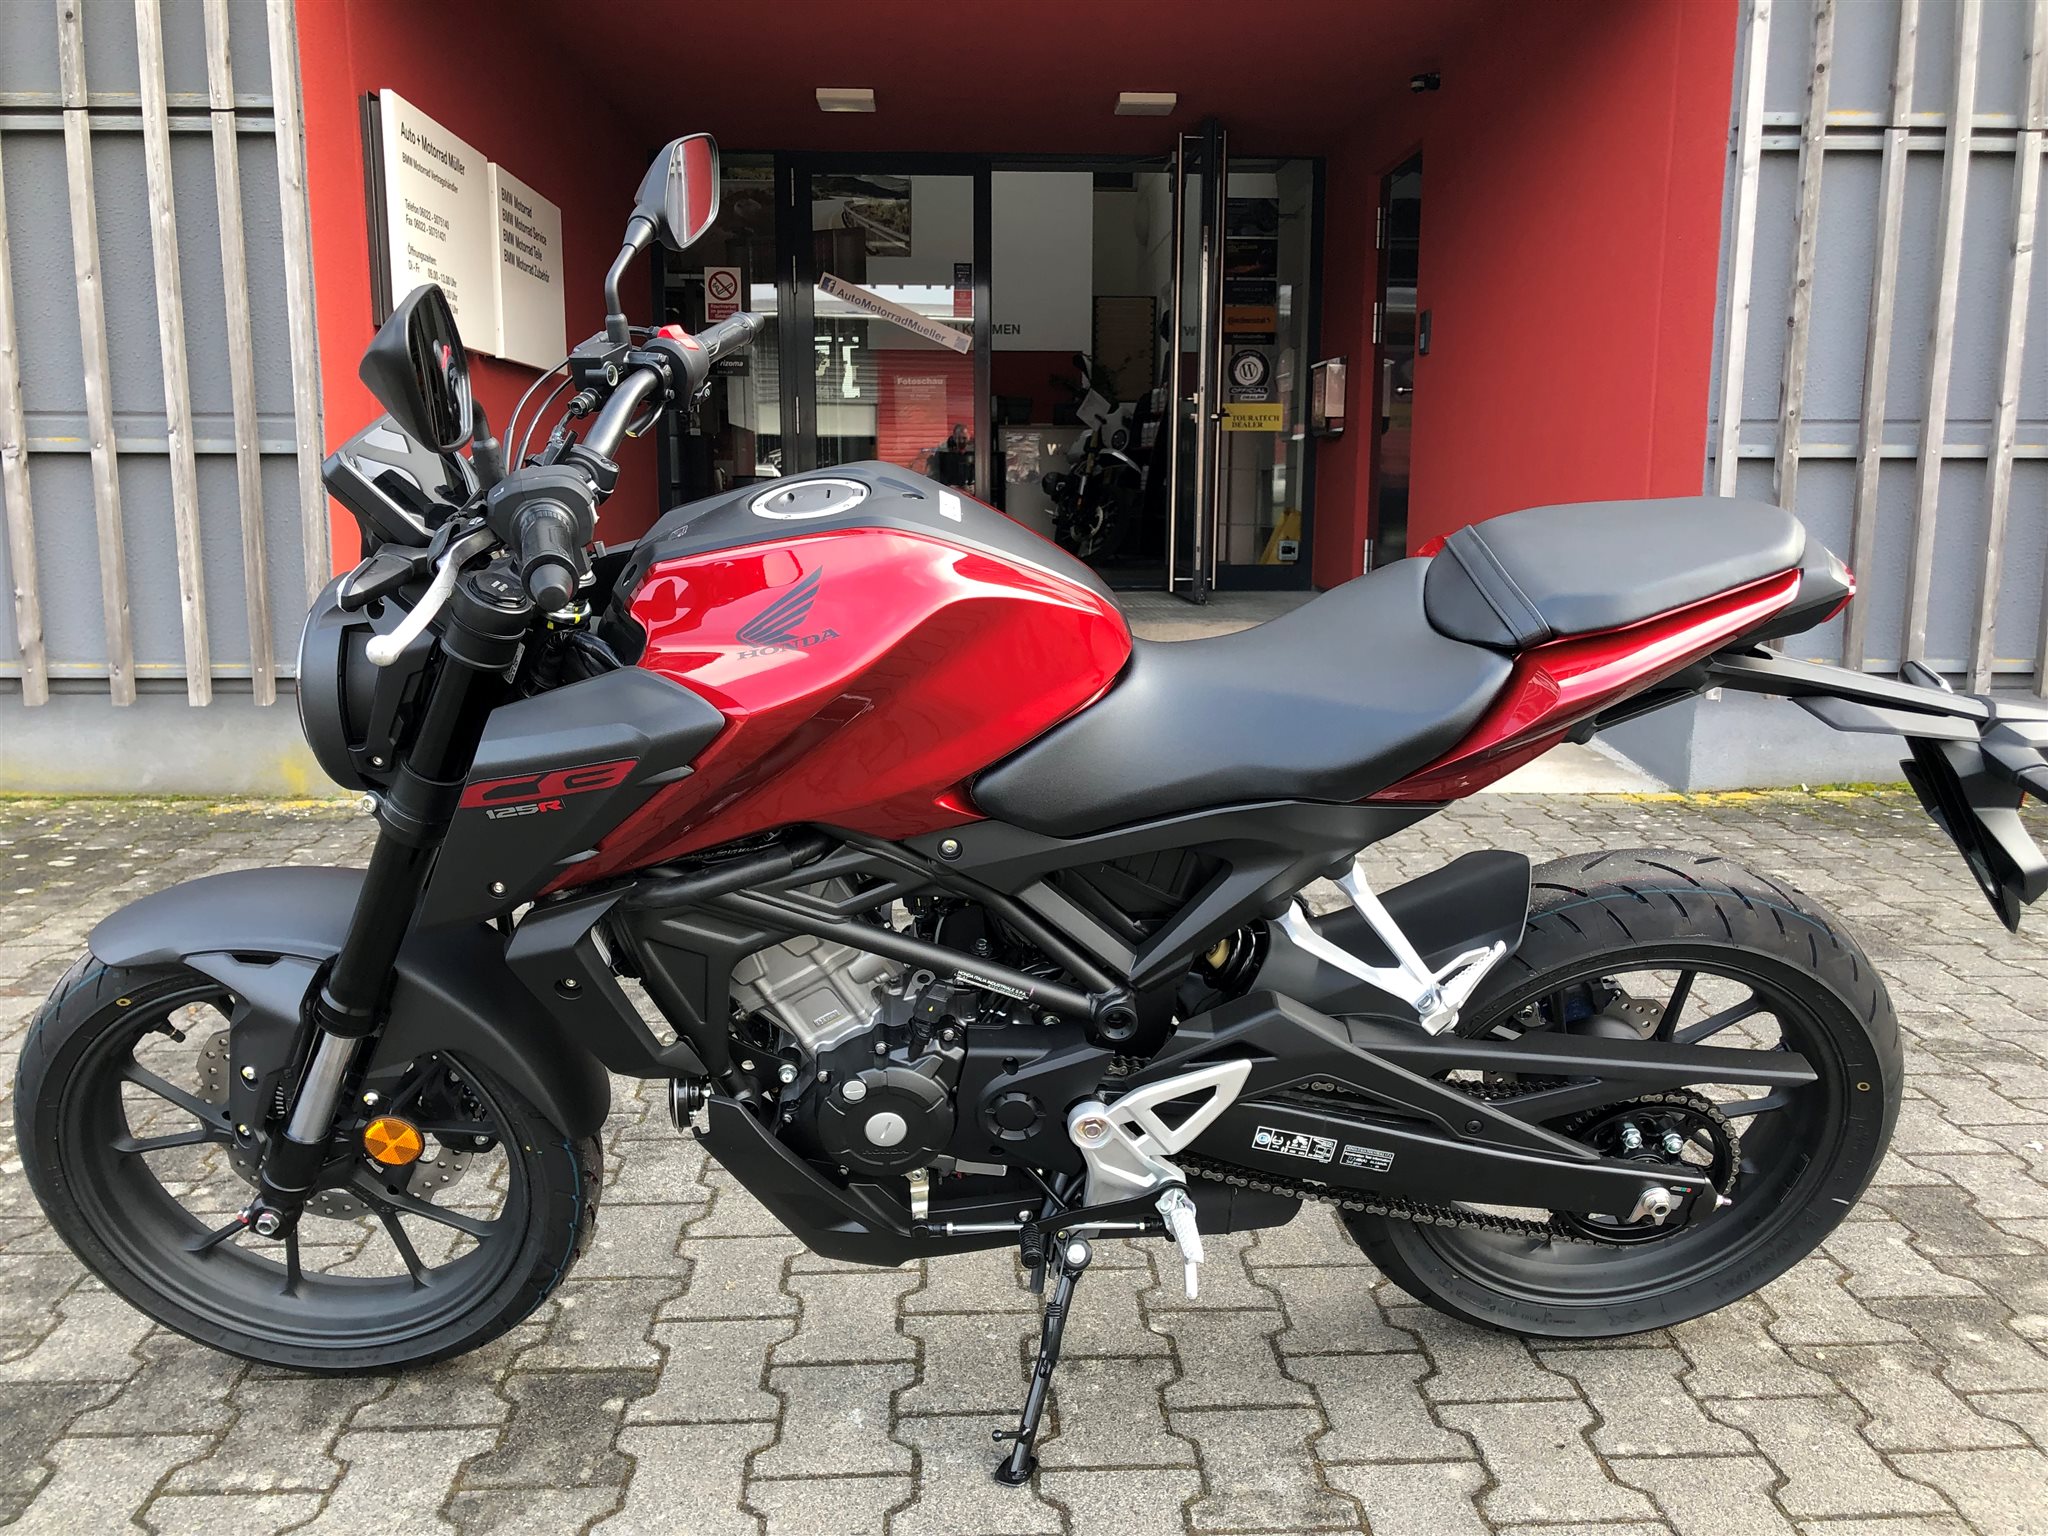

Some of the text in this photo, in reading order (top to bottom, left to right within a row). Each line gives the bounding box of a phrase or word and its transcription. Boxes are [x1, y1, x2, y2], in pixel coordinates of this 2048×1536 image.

[401, 121, 415, 145] Auto
[417, 134, 421, 146] +
[421, 134, 448, 165] Motorrad
[402, 151, 413, 167] BMW
[413, 158, 431, 178] Motorrad
[501, 187, 533, 219] BMW Motorrad
[405, 213, 413, 227] Fax
[502, 207, 547, 246] BMW Motorrad Service
[503, 228, 543, 262] BMW Motorrad Teile
[504, 248, 550, 283] BMW Motorrad Zubehör
[836, 288, 947, 344] AutoMotorradMueller
[719, 359, 744, 367] rizoma
[897, 377, 944, 385] Fotoschau
[736, 628, 840, 661] HONDA
[486, 799, 562, 820] 125R
